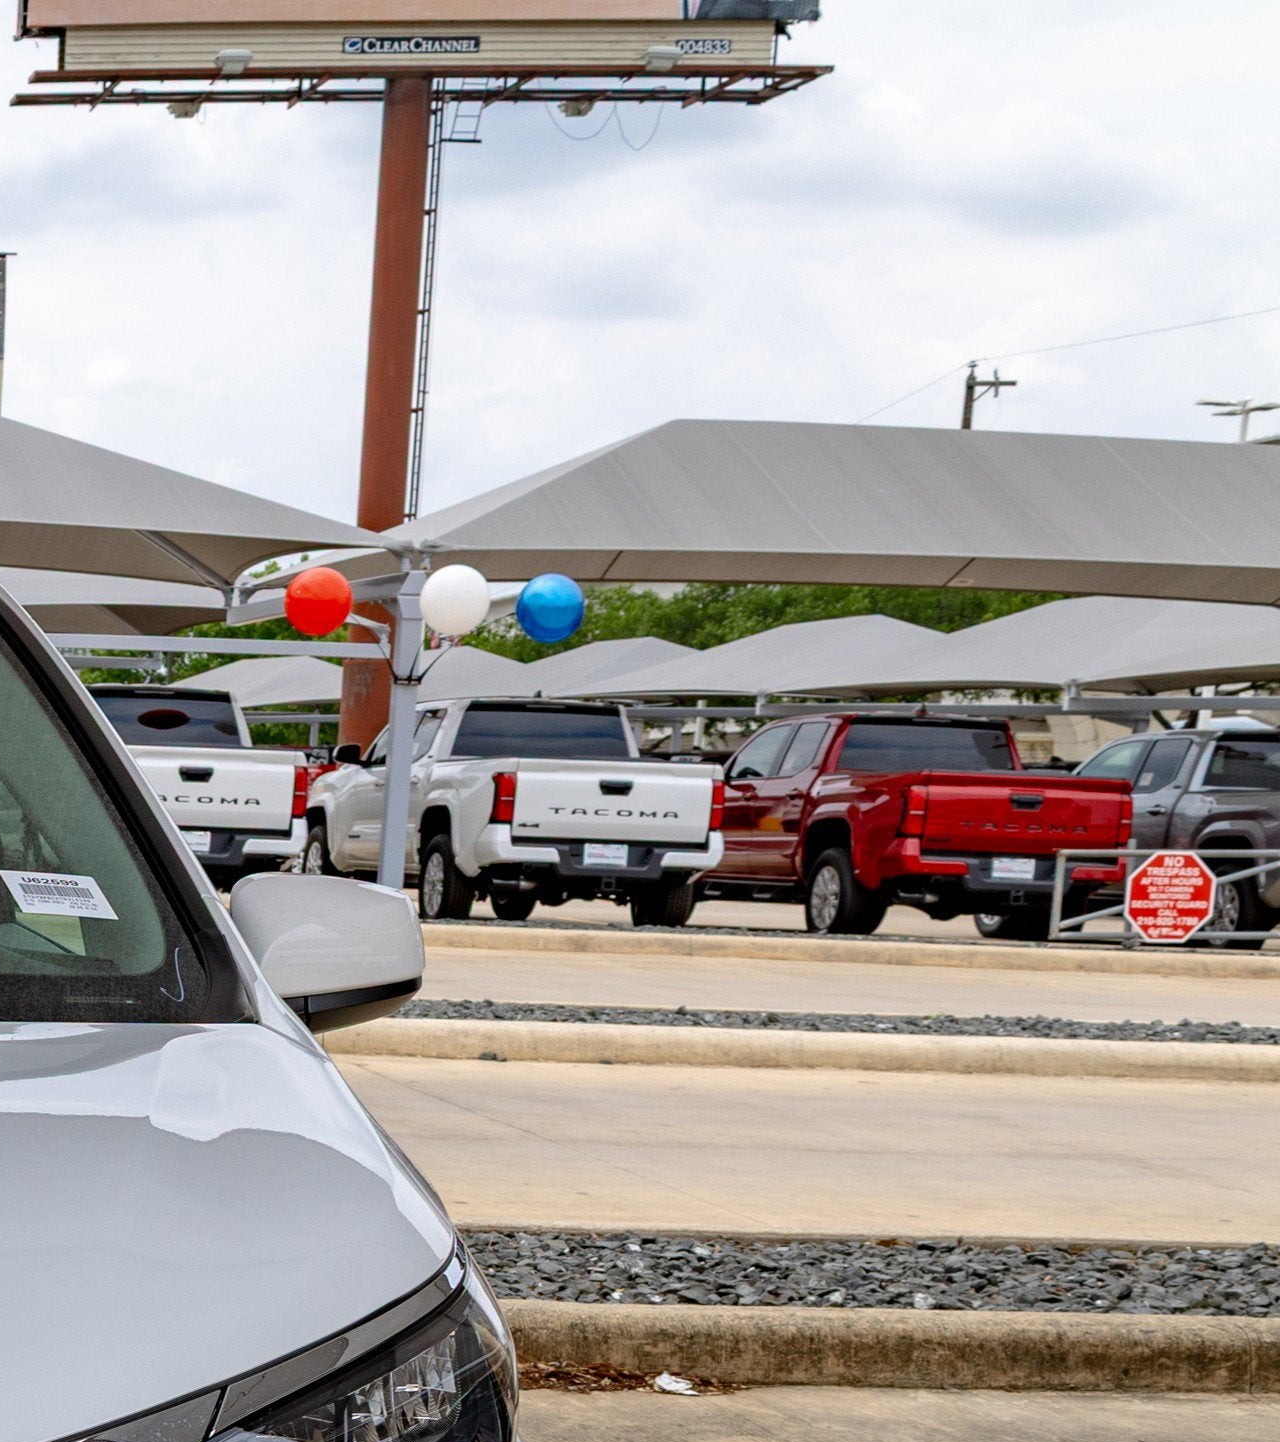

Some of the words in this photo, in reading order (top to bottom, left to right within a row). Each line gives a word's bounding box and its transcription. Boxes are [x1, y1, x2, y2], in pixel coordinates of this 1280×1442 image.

[678, 40, 730, 54] 004833
[548, 807, 679, 819] TACOMA
[959, 822, 1088, 834] TACOMA
[1163, 856, 1185, 867] NO
[1146, 867, 1200, 876] TRESPASS
[1140, 876, 1169, 885] AFTER
[1170, 877, 1204, 886] HOURS
[1131, 900, 1175, 908] SECURITY
[1175, 900, 1208, 909] GUARD
[1157, 909, 1179, 917] CALL
